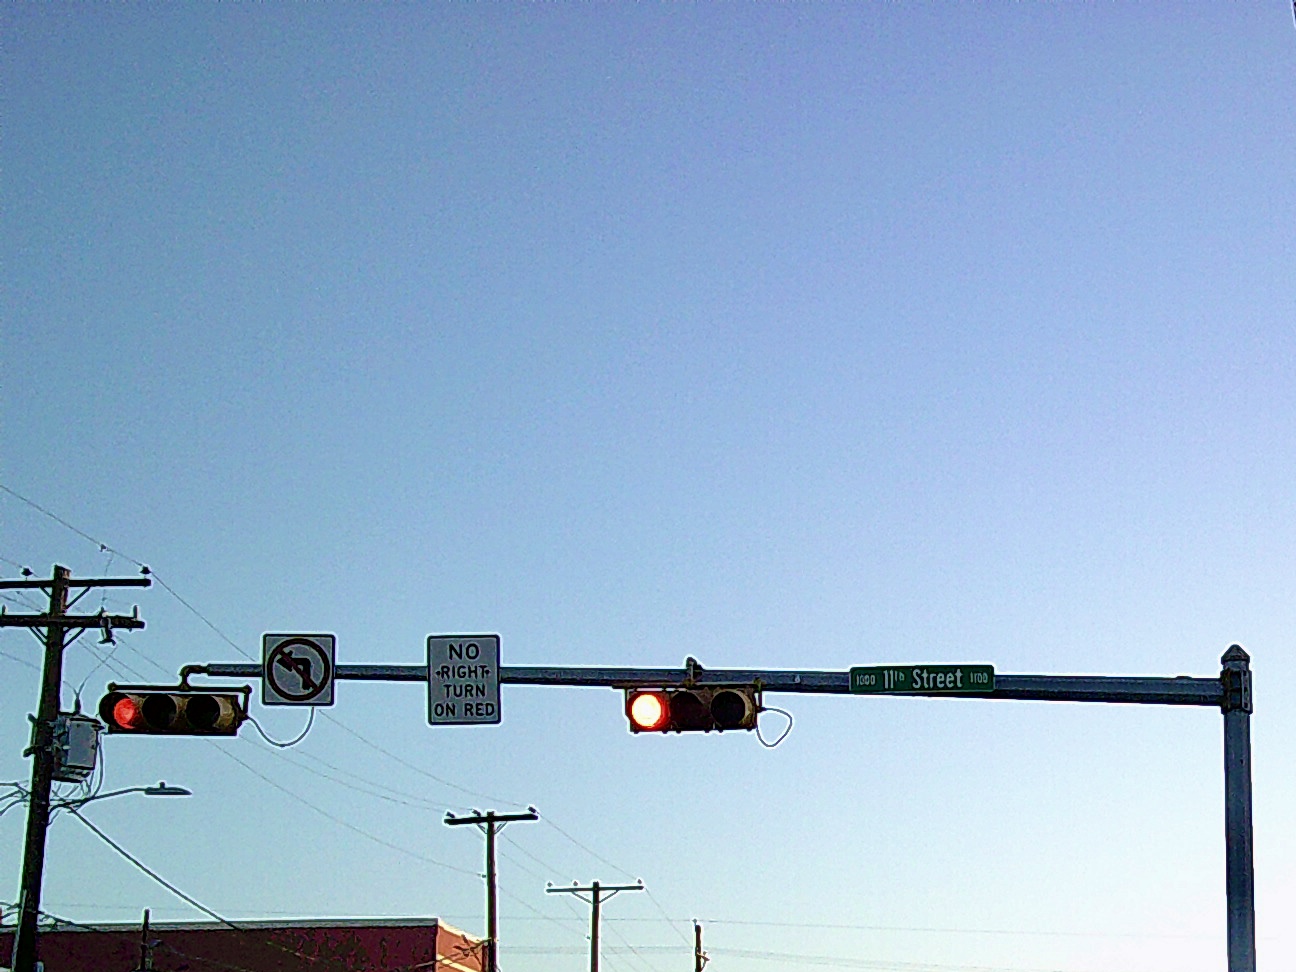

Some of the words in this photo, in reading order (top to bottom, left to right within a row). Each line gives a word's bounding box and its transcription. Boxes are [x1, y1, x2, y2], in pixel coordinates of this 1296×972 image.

[448, 643, 480, 660] NO
[440, 665, 488, 680] RIGHT
[912, 668, 964, 689] Street
[443, 684, 486, 698] TURN
[434, 703, 456, 717] ON
[464, 703, 495, 717] RED
